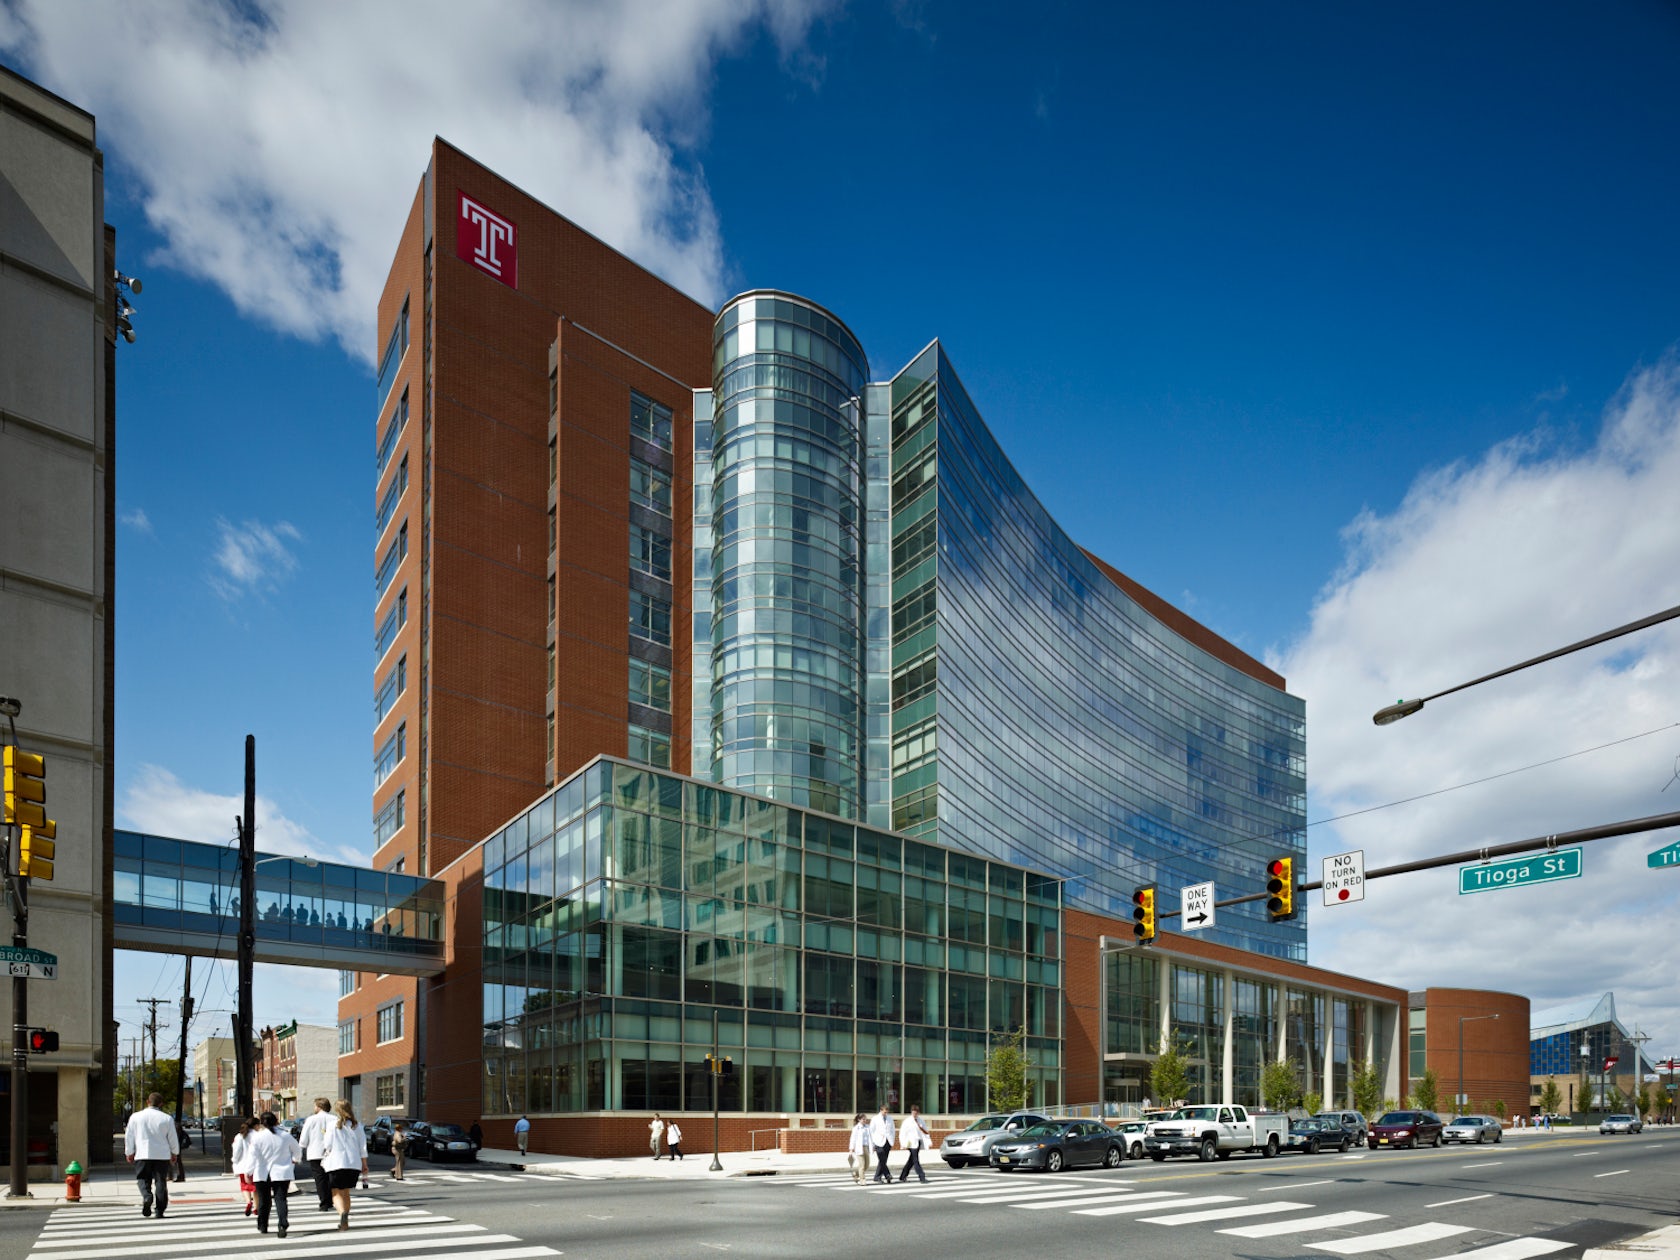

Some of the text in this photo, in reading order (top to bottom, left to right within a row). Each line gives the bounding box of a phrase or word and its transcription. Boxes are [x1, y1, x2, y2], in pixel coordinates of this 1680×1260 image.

[462, 197, 513, 276] T
[1334, 855, 1352, 867] NO
[1660, 850, 1680, 864] TI
[1331, 866, 1356, 877] TURN
[1474, 858, 1566, 885] Tioga St
[1325, 875, 1362, 890] ON RED
[1187, 887, 1207, 900] ONE
[1187, 899, 1208, 912] WAY
[0, 951, 40, 963] BROAD
[44, 966, 53, 977] N
